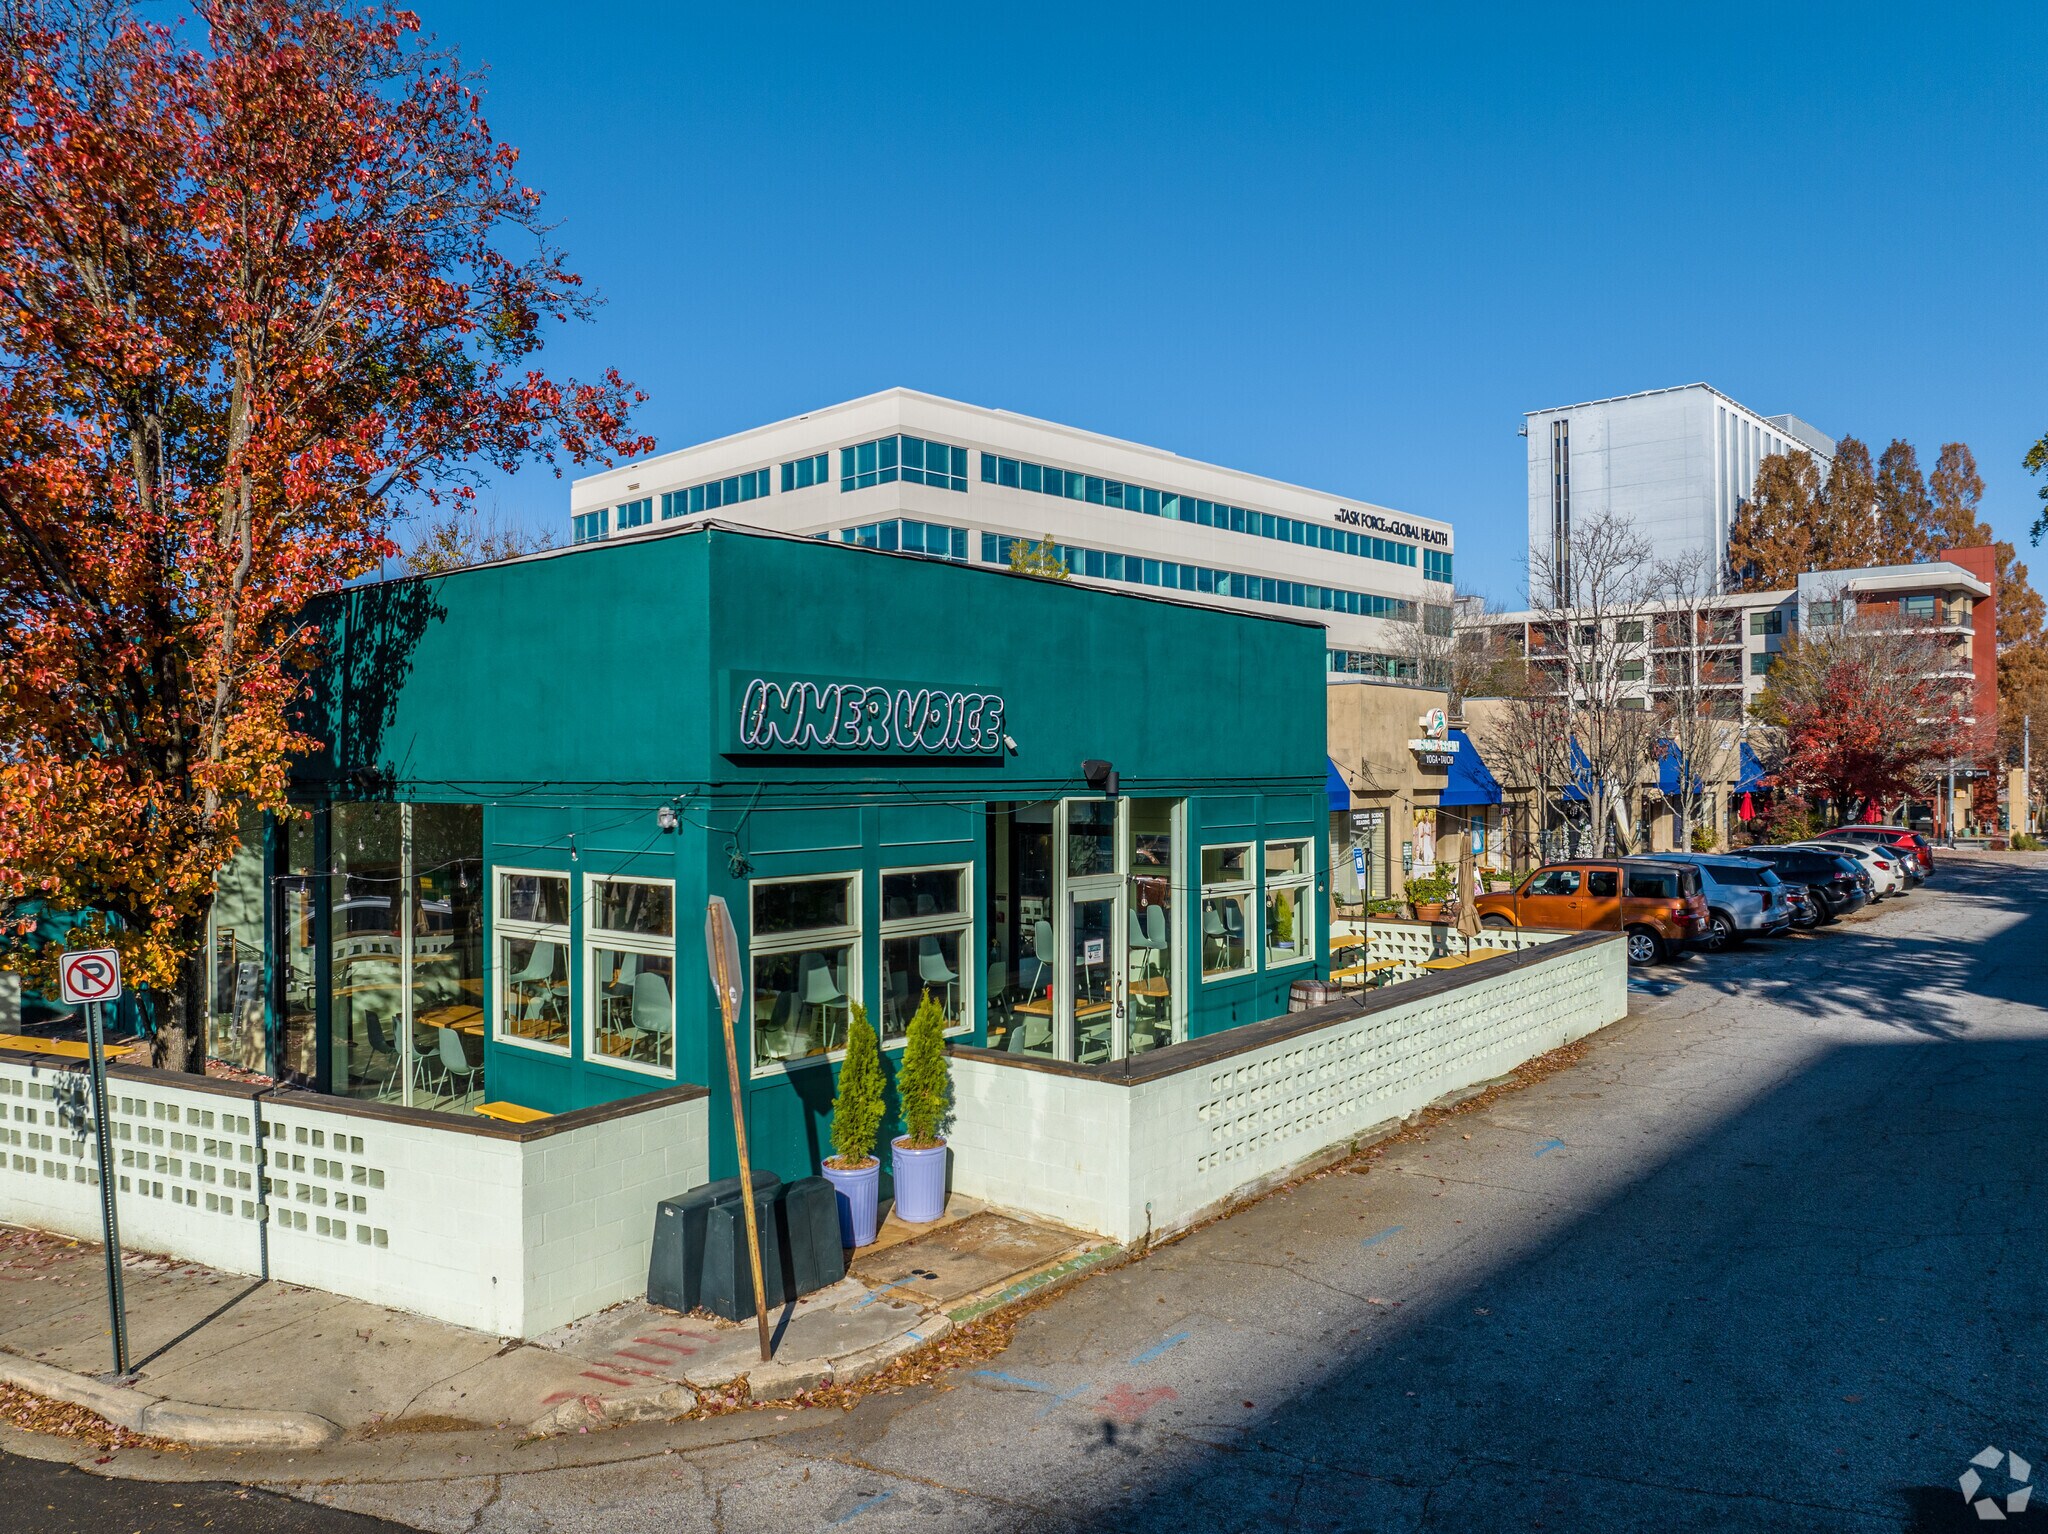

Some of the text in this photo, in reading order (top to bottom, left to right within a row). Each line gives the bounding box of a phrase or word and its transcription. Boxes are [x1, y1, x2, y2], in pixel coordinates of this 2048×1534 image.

[1340, 508, 1360, 526] TASK
[1361, 513, 1385, 532] FORCE
[1391, 521, 1420, 540] GLOBAL
[1421, 528, 1448, 546] HEALTH
[738, 677, 1004, 751] INNER VOICE
[81, 963, 105, 990] P
